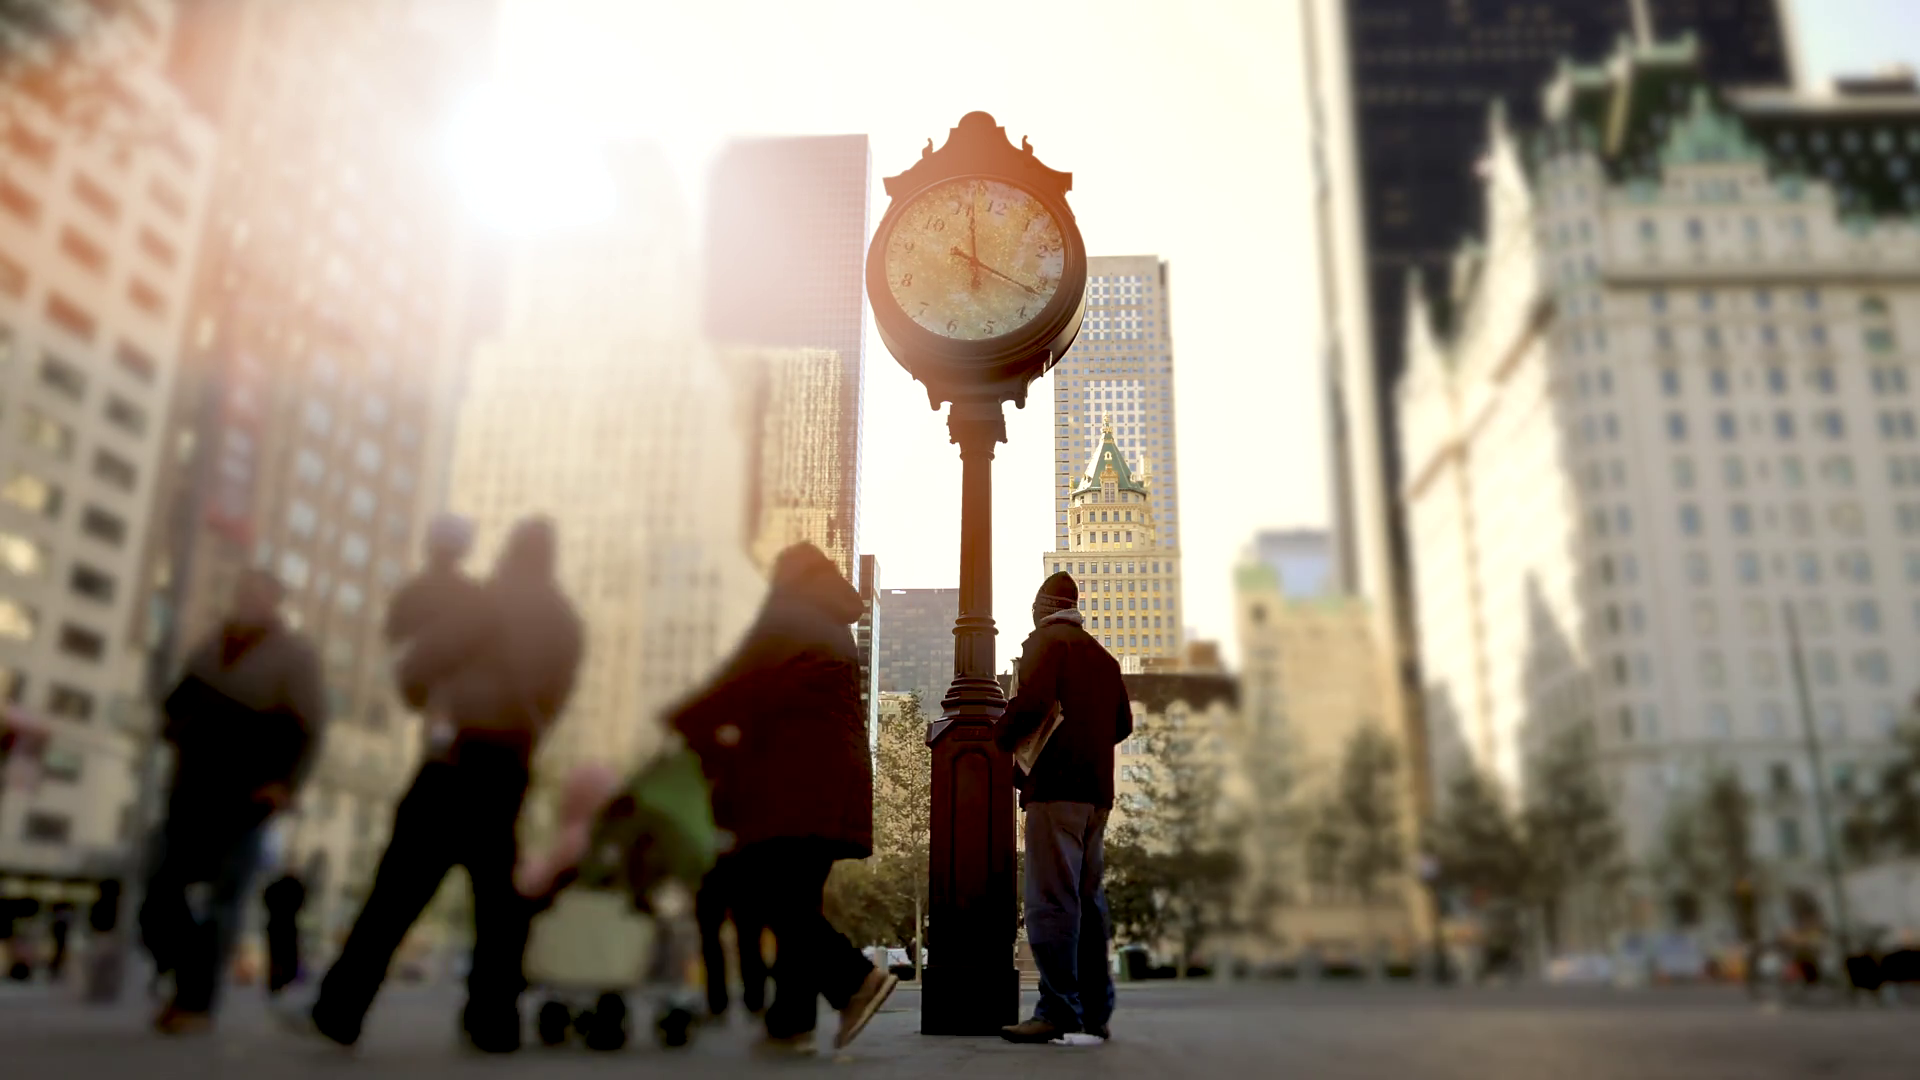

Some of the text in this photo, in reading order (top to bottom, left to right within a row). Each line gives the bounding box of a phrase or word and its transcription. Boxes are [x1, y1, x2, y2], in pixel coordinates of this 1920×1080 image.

[986, 199, 1007, 216] 12
[923, 214, 945, 233] 10
[1022, 219, 1031, 232] 1
[904, 241, 915, 254] 9
[1035, 244, 1049, 259] 2
[901, 272, 913, 287] 8
[919, 301, 930, 316] 7
[1015, 303, 1027, 319] 4
[946, 319, 958, 334] 6
[983, 320, 996, 335] 5
